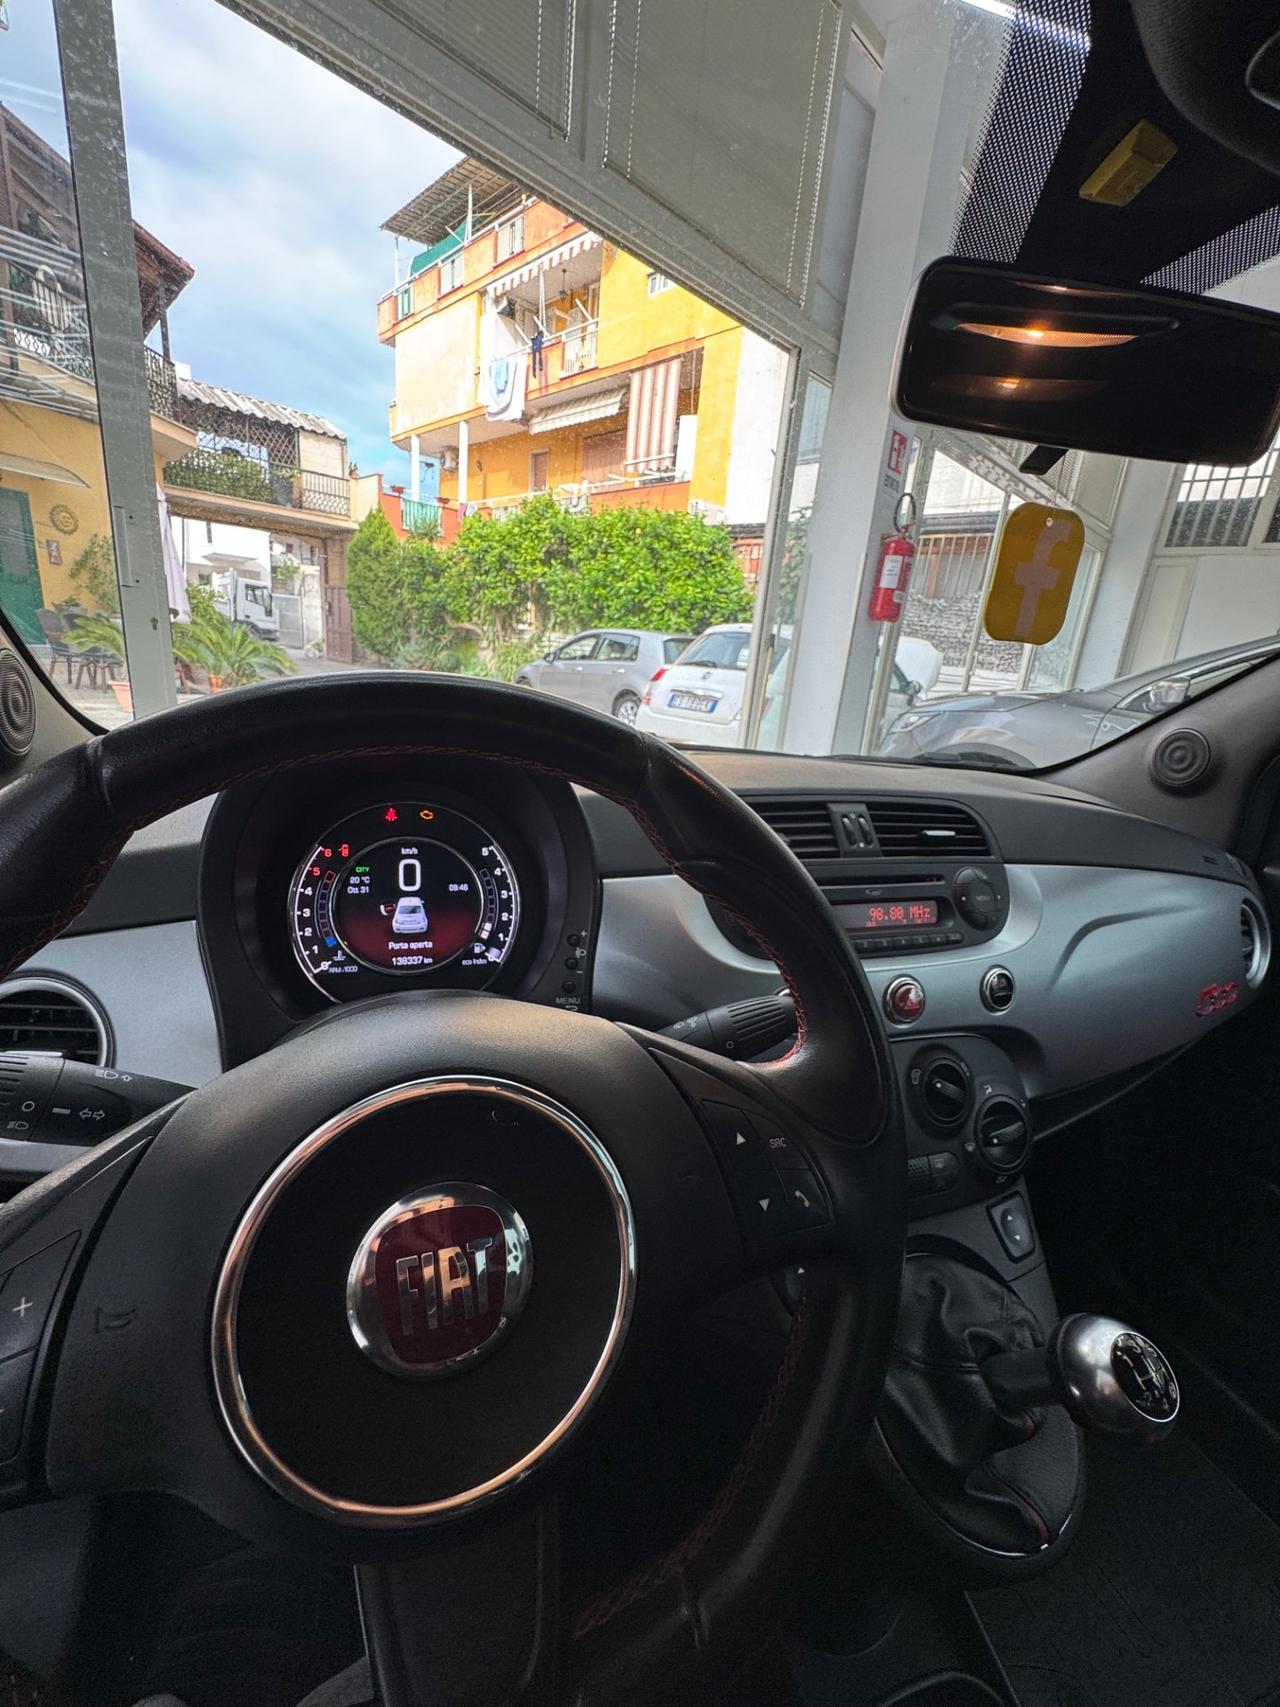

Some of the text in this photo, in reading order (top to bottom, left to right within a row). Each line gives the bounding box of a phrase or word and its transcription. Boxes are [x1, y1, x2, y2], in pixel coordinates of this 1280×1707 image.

[324, 848, 332, 858] 6
[401, 847, 419, 855] km/h
[481, 847, 489, 856] 5
[312, 866, 321, 876] 5
[398, 858, 422, 892] 0
[494, 867, 502, 876] 4
[349, 876, 360, 884] 20
[304, 886, 313, 896] 4
[360, 885, 370, 894] 31
[500, 890, 509, 899] 3
[302, 908, 311, 917] 3
[909, 904, 930, 919] MHz
[501, 912, 509, 921] 2
[304, 927, 313, 936] 2
[498, 933, 505, 942] 1
[312, 945, 320, 954] 1
[388, 941, 433, 950] Porta aperta
[555, 997, 581, 1005] MENU
[769, 1137, 787, 1150] SRC
[396, 1236, 493, 1336] FIAT
